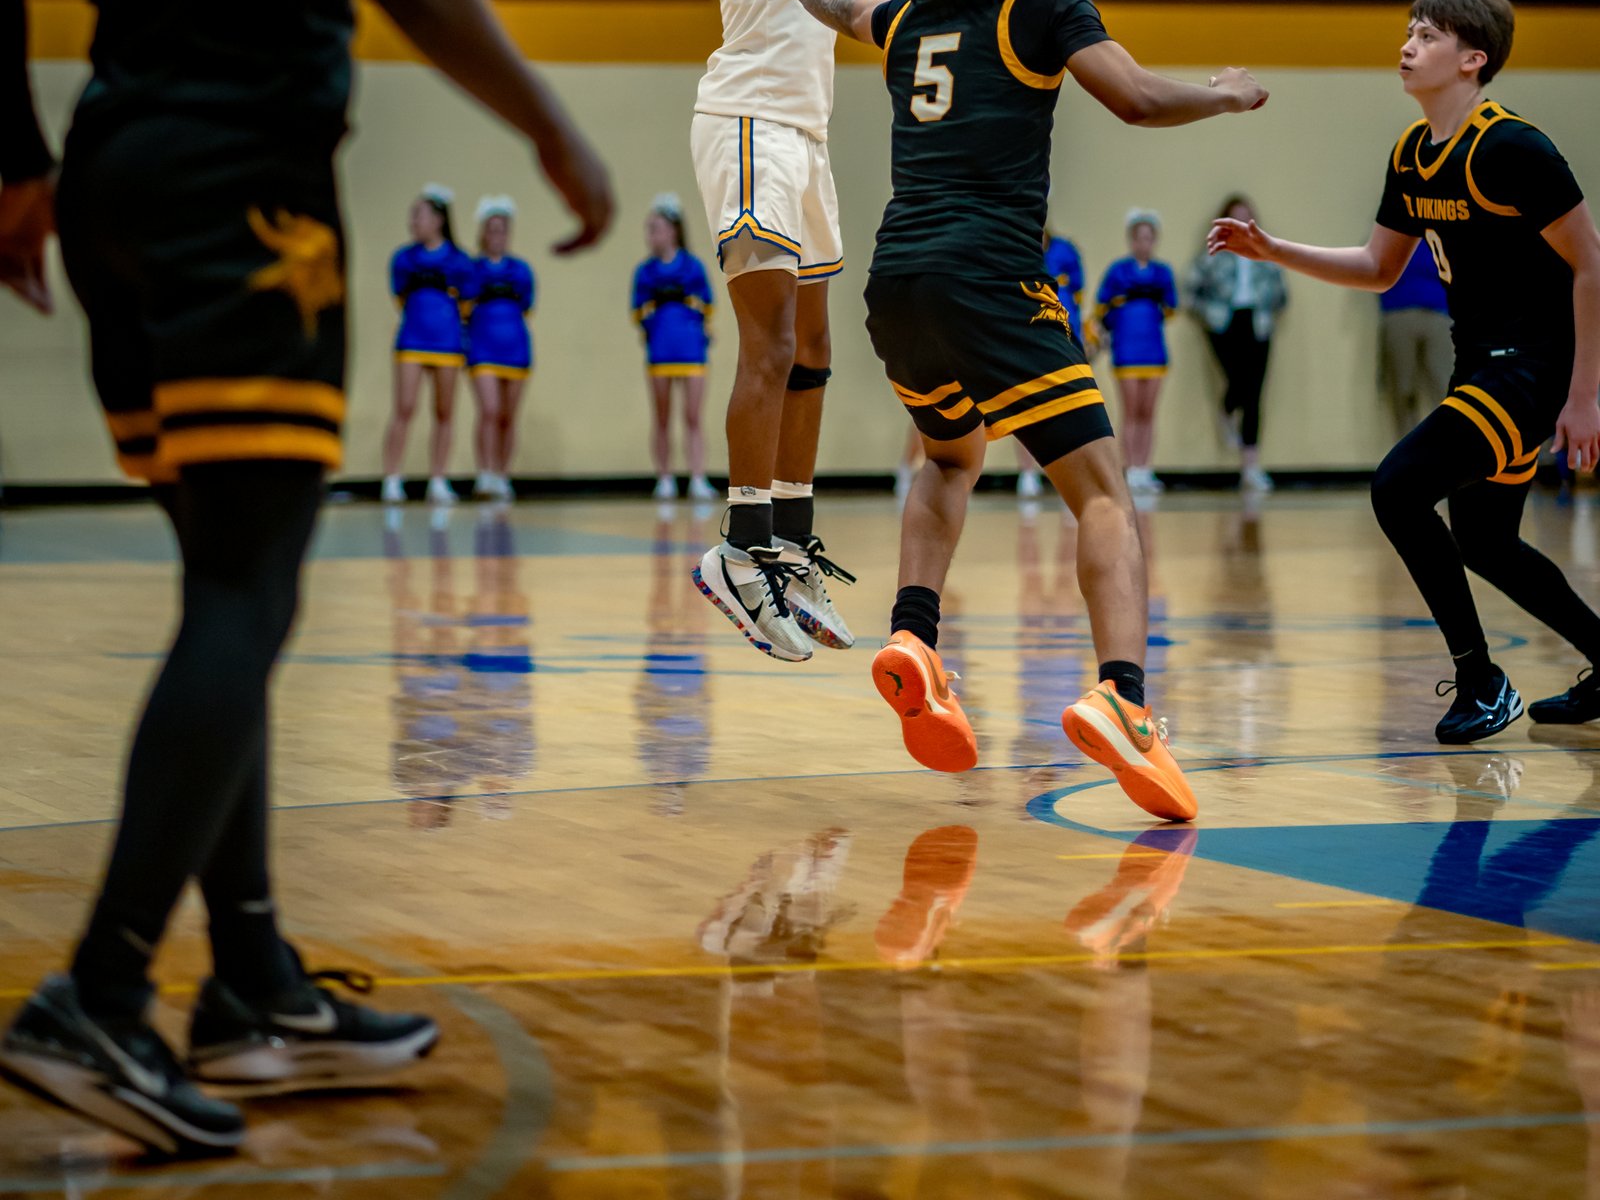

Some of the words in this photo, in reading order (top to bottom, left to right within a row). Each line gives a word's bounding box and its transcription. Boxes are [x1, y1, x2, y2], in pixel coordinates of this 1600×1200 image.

[910, 31, 962, 123] 5
[1416, 196, 1470, 222] VIKINGS
[1425, 228, 1453, 285] 0
